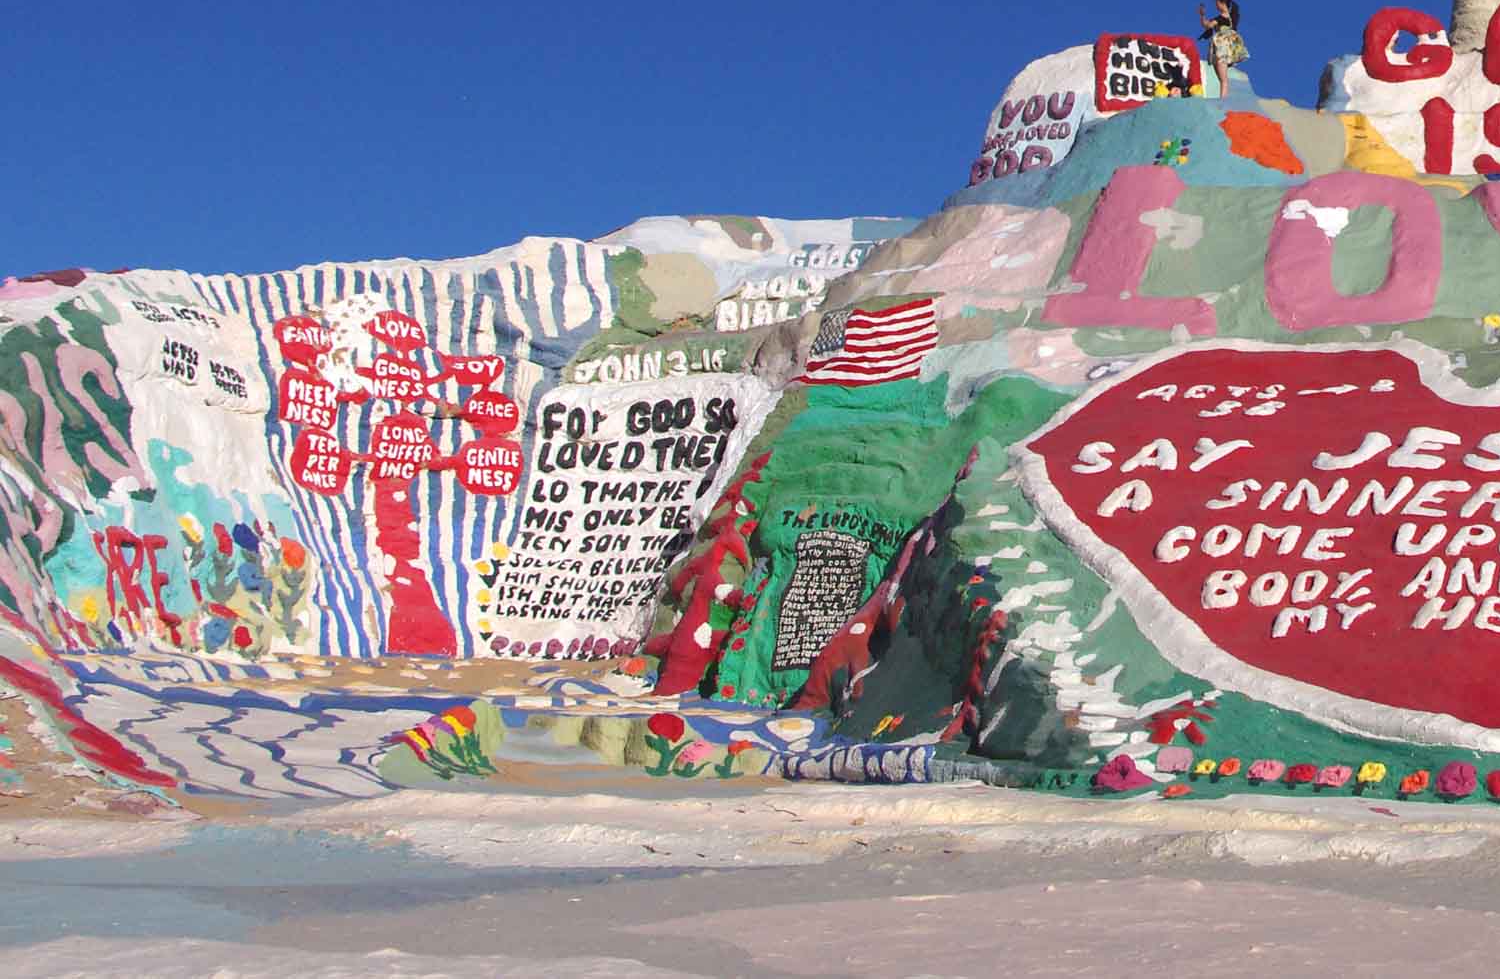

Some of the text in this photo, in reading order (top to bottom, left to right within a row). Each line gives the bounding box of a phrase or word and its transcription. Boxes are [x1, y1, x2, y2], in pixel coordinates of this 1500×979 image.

[1110, 73, 1156, 98] BIB
[997, 90, 1076, 130] YOU
[282, 326, 331, 351] FAITH
[374, 314, 423, 340] LOVE
[375, 358, 422, 380] GOOD
[452, 358, 499, 377] JOY
[574, 349, 661, 383] JOHN
[288, 378, 338, 409] MEEK
[373, 378, 424, 398] NESS
[1137, 383, 1287, 402] ACTS
[285, 400, 332, 429] NESS
[467, 399, 514, 418] PEACE
[626, 397, 696, 436] GOD
[307, 433, 341, 455] TEM
[381, 426, 430, 444] LONG
[305, 454, 340, 472] PER
[375, 442, 433, 463] SUFFER
[466, 447, 520, 468] GENTLE
[538, 441, 645, 472] LOVED
[1071, 436, 1255, 474] SAY
[379, 462, 416, 480] ING
[466, 468, 514, 491] NESS
[1096, 478, 1154, 518] A
[583, 506, 658, 532] ONLY
[783, 509, 819, 529] THE
[579, 534, 632, 554] SON
[1153, 522, 1354, 563] COME
[504, 572, 542, 586] HIM
[545, 575, 625, 596] SHOULD
[540, 590, 584, 607] BUT
[588, 594, 639, 609] HAVE
[496, 603, 572, 620] LASTING
[1271, 602, 1377, 639] MY
